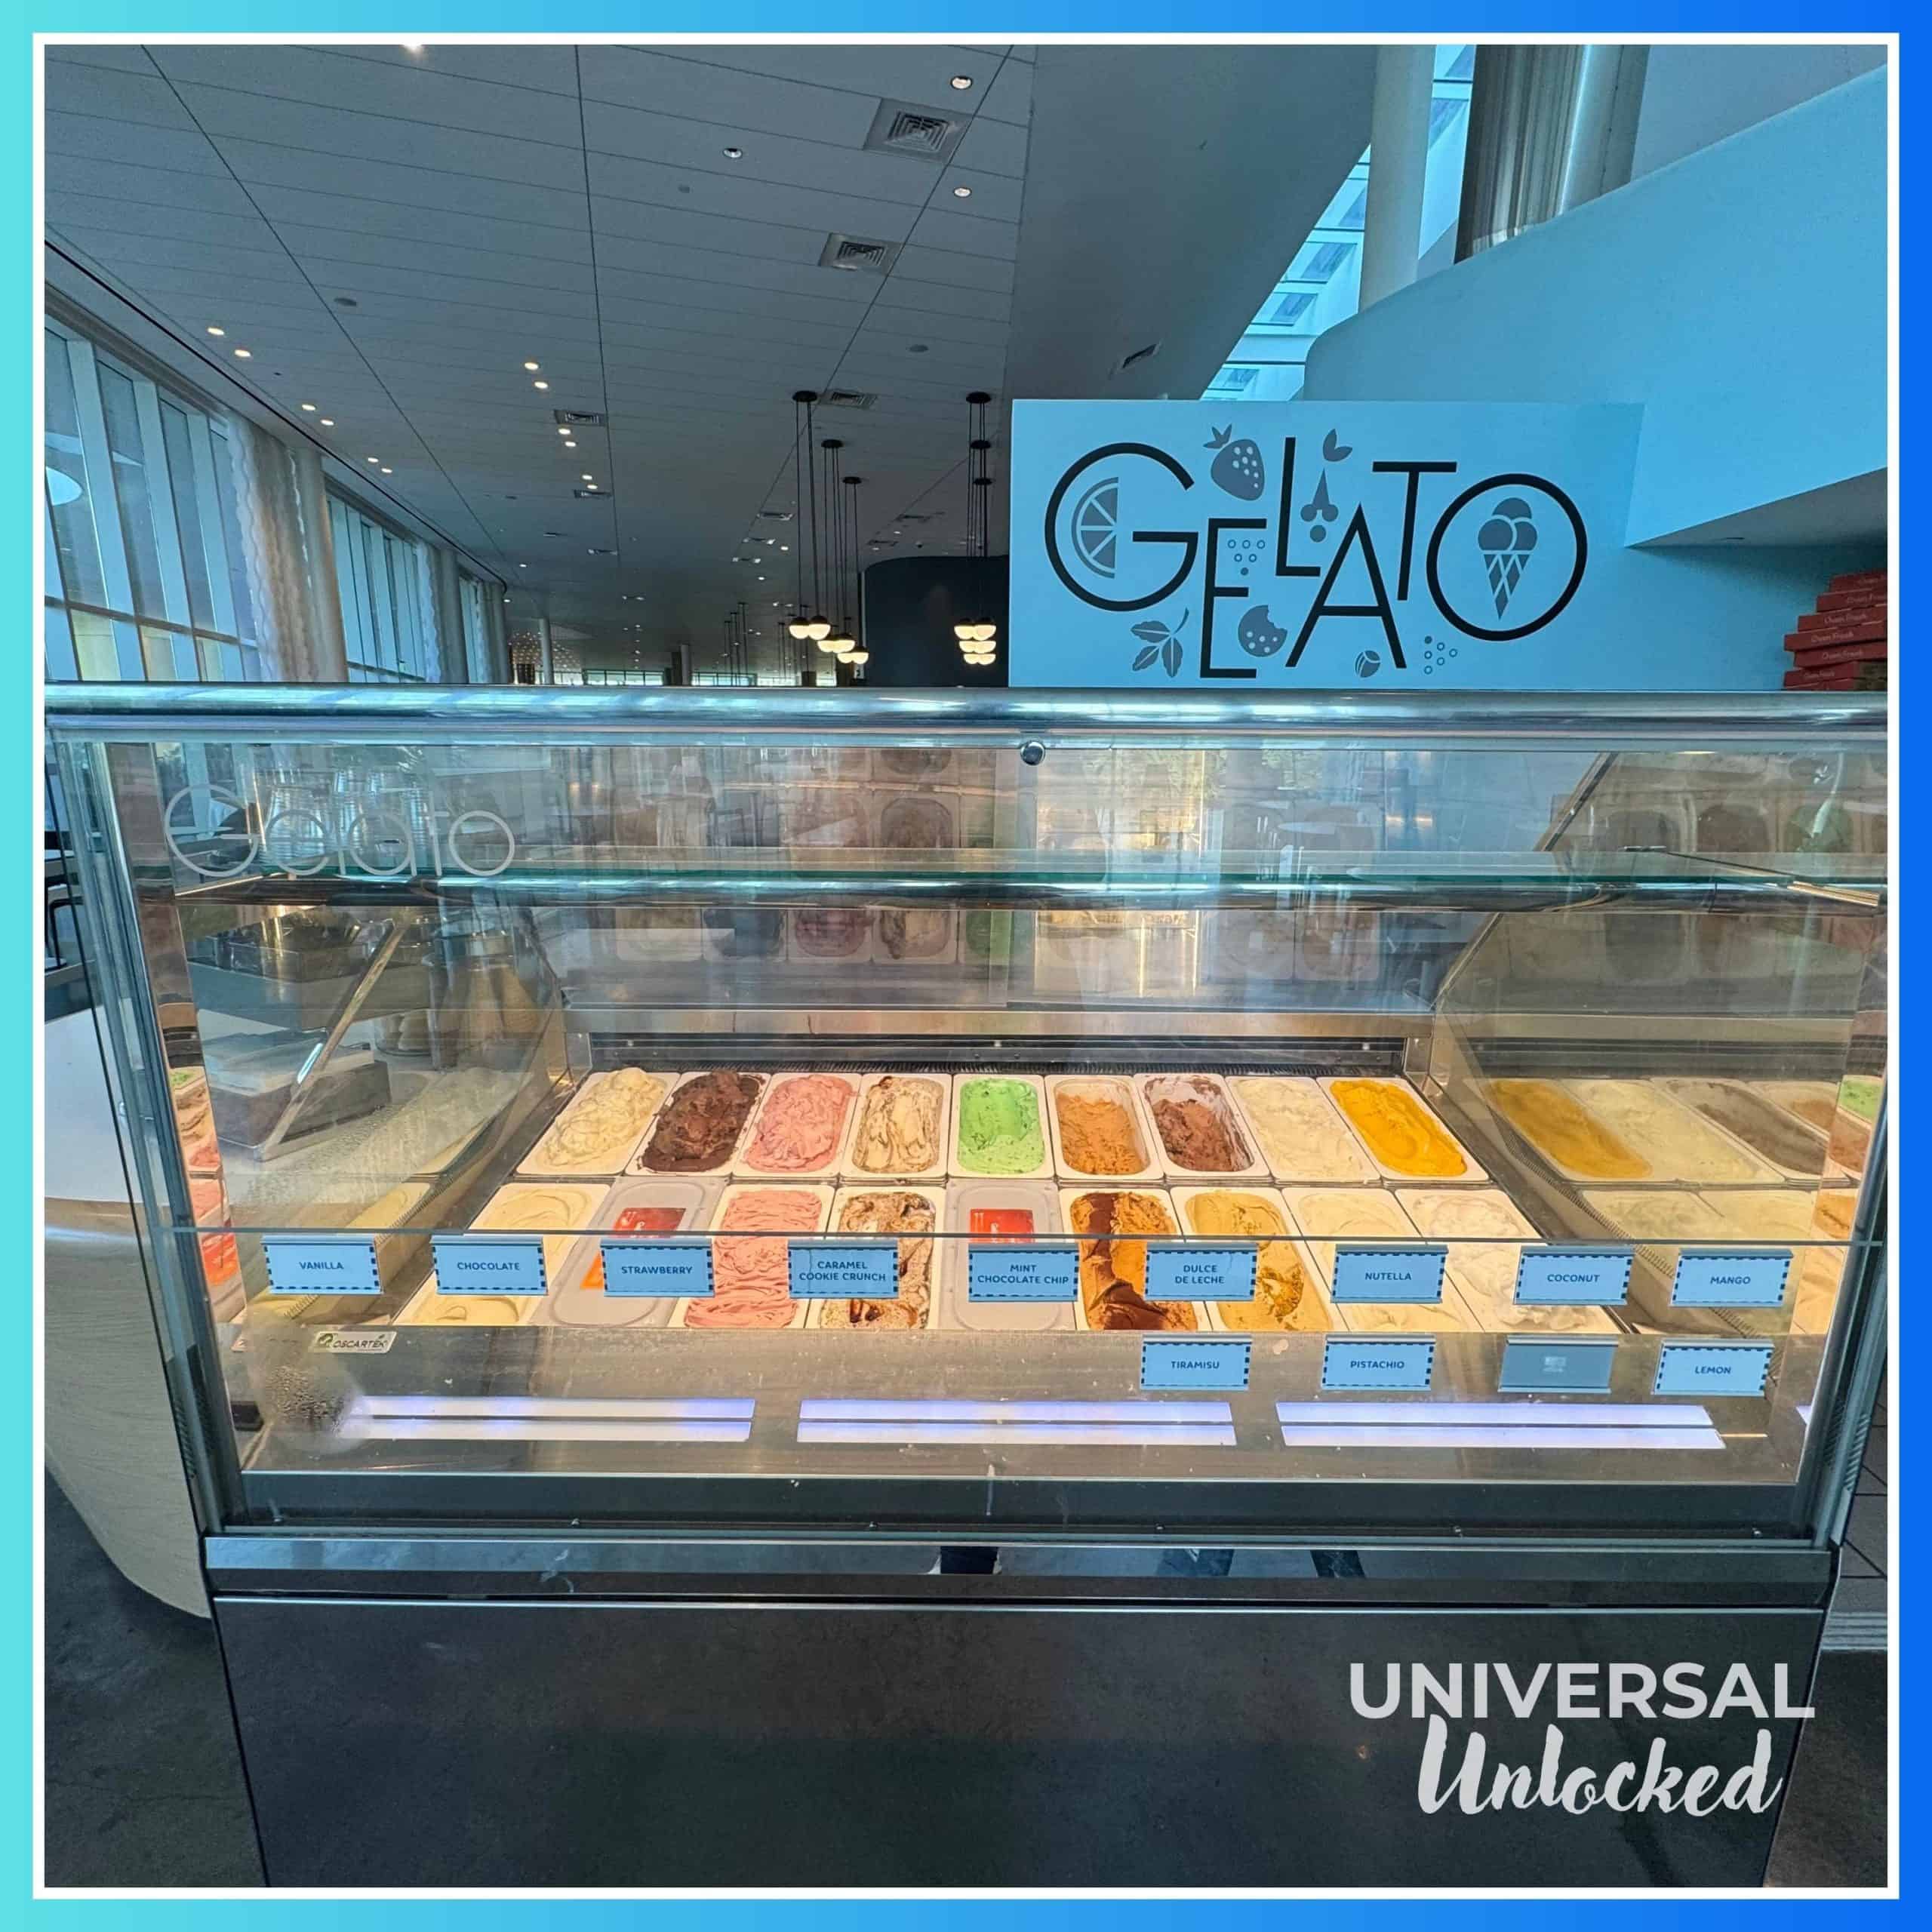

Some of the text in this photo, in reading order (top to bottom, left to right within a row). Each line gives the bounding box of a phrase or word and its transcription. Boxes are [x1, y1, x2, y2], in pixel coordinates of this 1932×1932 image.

[1044, 436, 1588, 678] GELATO
[165, 783, 515, 878] Gelato
[299, 1261, 345, 1270] VANILLA
[457, 1261, 520, 1271] CHOCOLATE
[817, 1260, 868, 1269] CARAMEL
[1009, 1264, 1037, 1273] MINT
[1183, 1264, 1217, 1273] DULCE
[621, 1266, 693, 1275] STRAWBERRY
[798, 1272, 886, 1281] COOKIE CRUNCH
[977, 1275, 1069, 1284] CHOCOLATE CHIP
[1174, 1275, 1225, 1284] DE LECHE
[1364, 1272, 1412, 1281] NUTELLA
[1546, 1273, 1601, 1283] COCONUT
[1709, 1275, 1752, 1285] MANGO
[1171, 1361, 1220, 1370] TIRAMISU
[1349, 1360, 1405, 1369] PISTACHIO
[1694, 1365, 1732, 1375] LEMON
